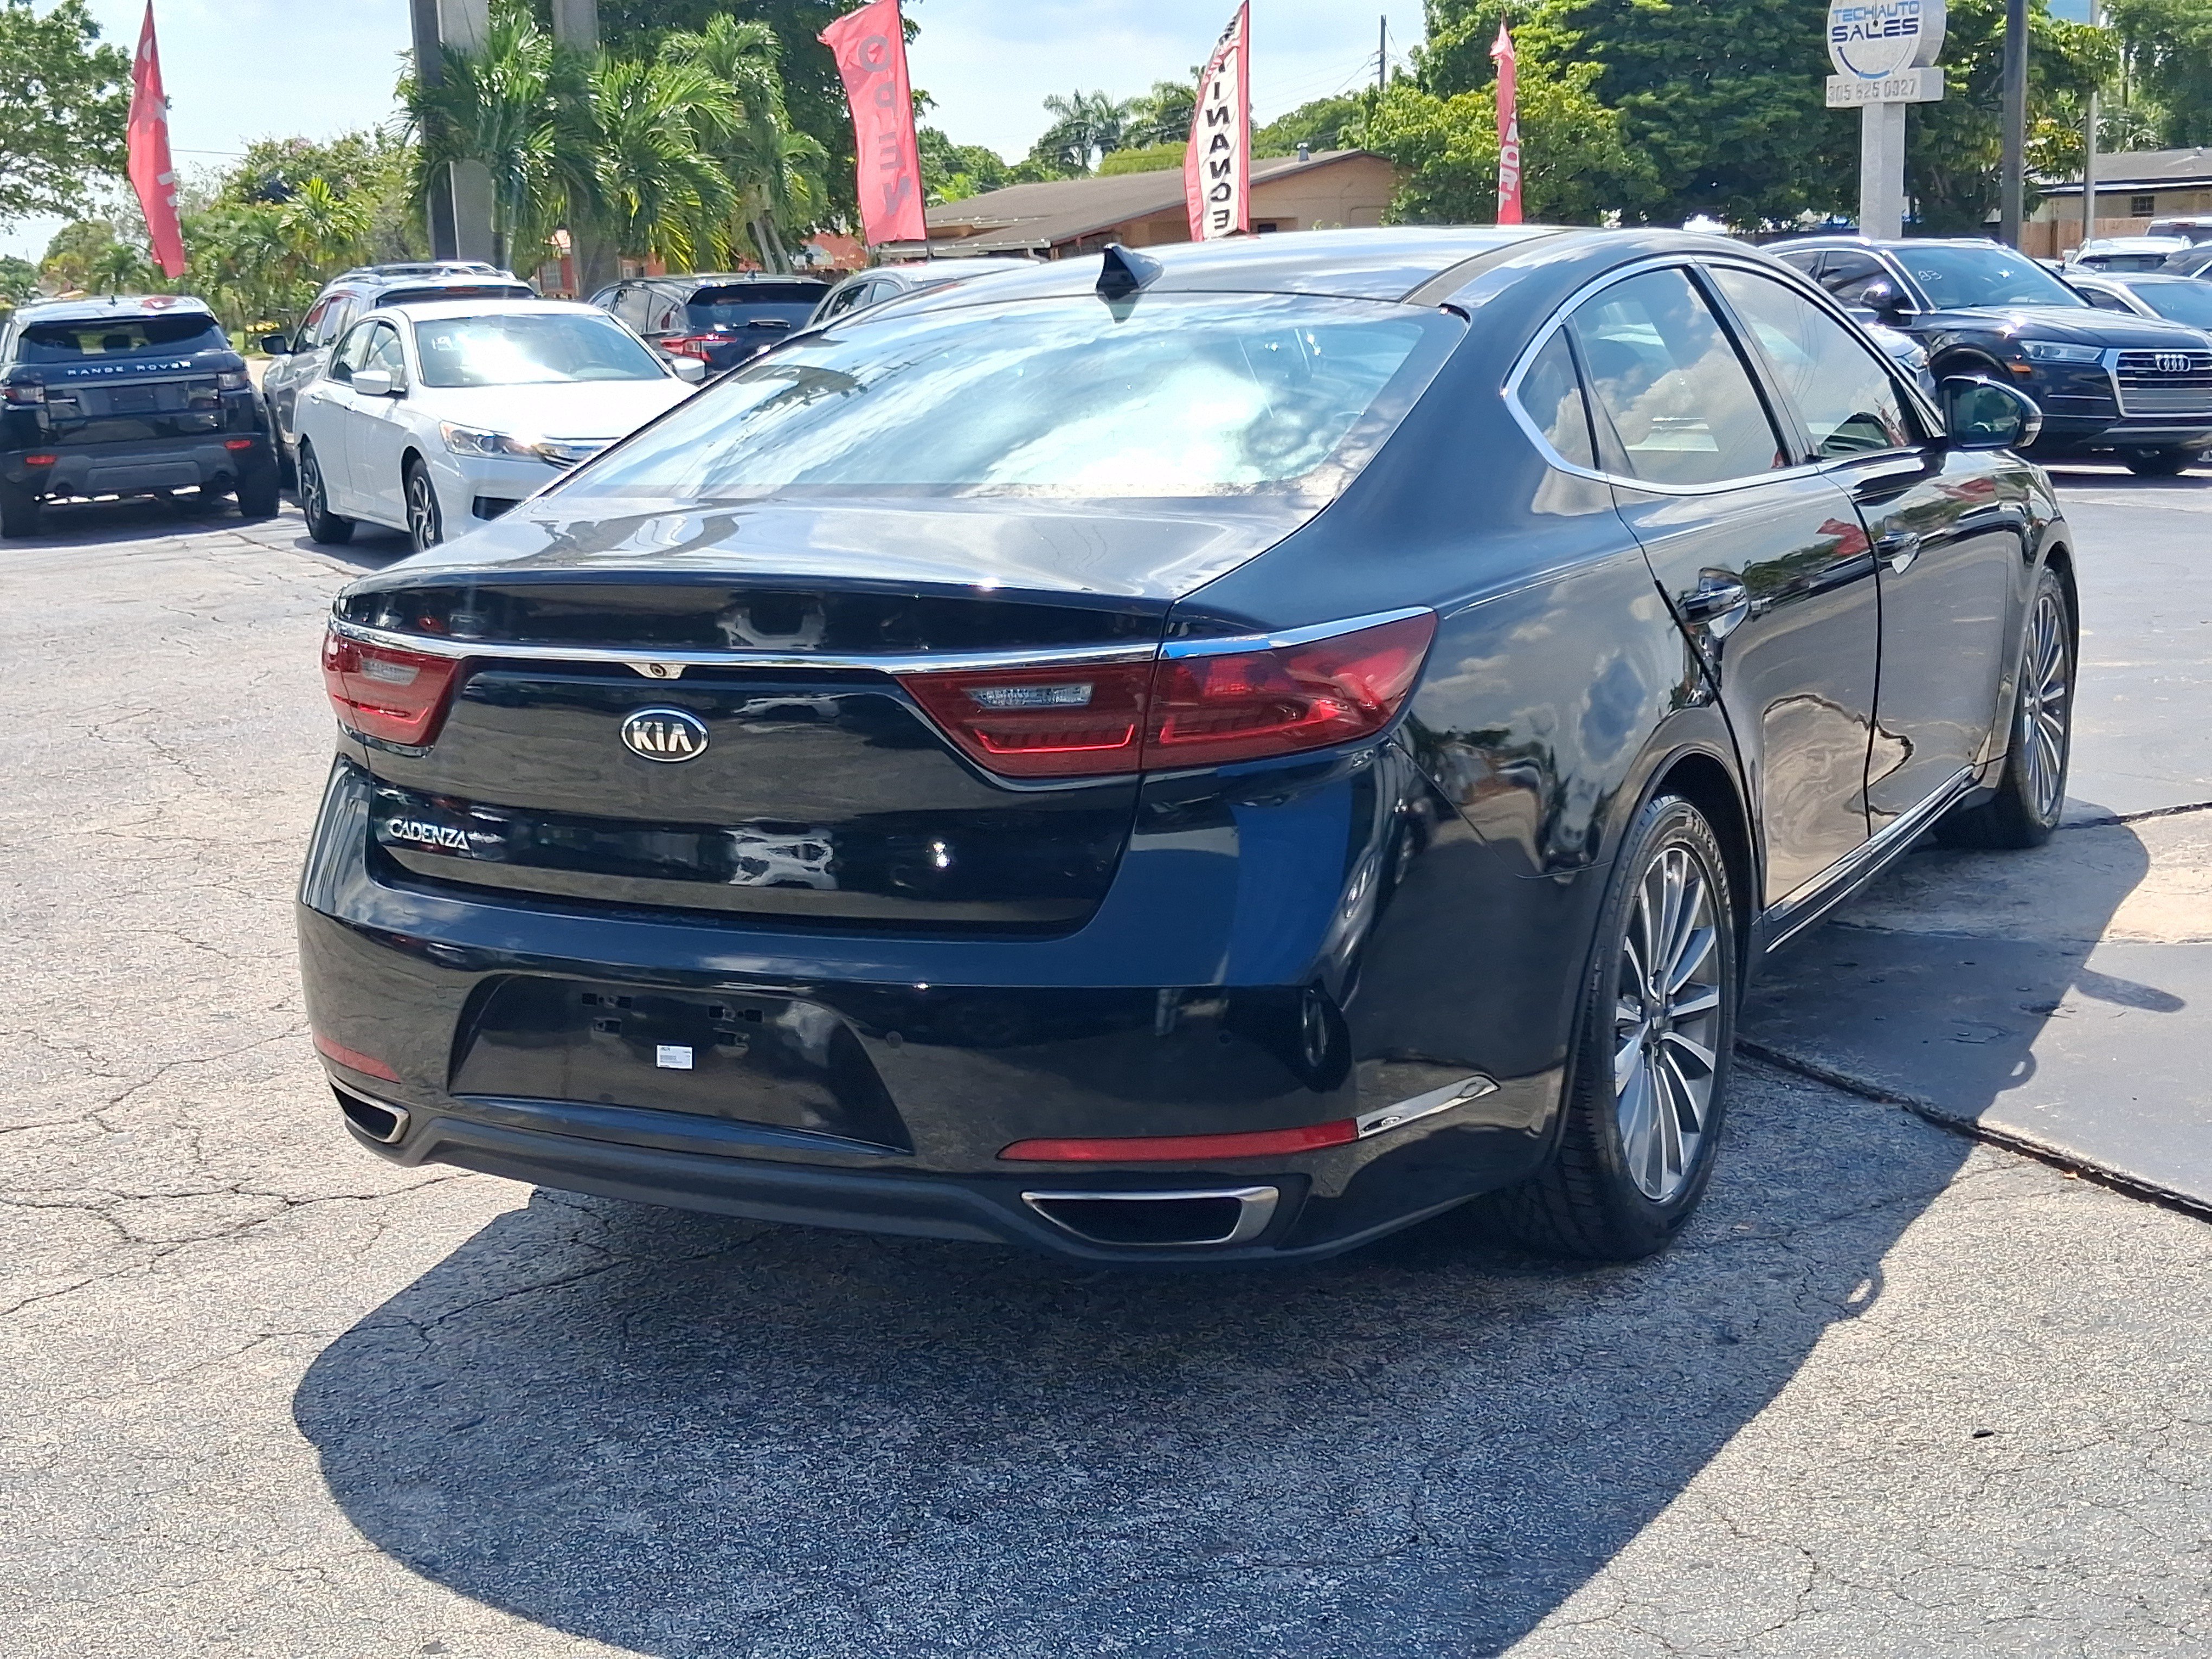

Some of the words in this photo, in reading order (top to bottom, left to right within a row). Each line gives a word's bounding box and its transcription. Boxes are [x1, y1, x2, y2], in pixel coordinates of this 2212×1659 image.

[1832, 5, 1874, 23] TECH
[1876, 1, 1920, 18] AUTO
[1832, 17, 1919, 43] SALES
[1828, 84, 1851, 102] 305
[67, 365, 125, 376] RANGE
[136, 361, 192, 372] ROVER
[632, 721, 693, 751] KIA
[389, 818, 470, 851] CADENZA
